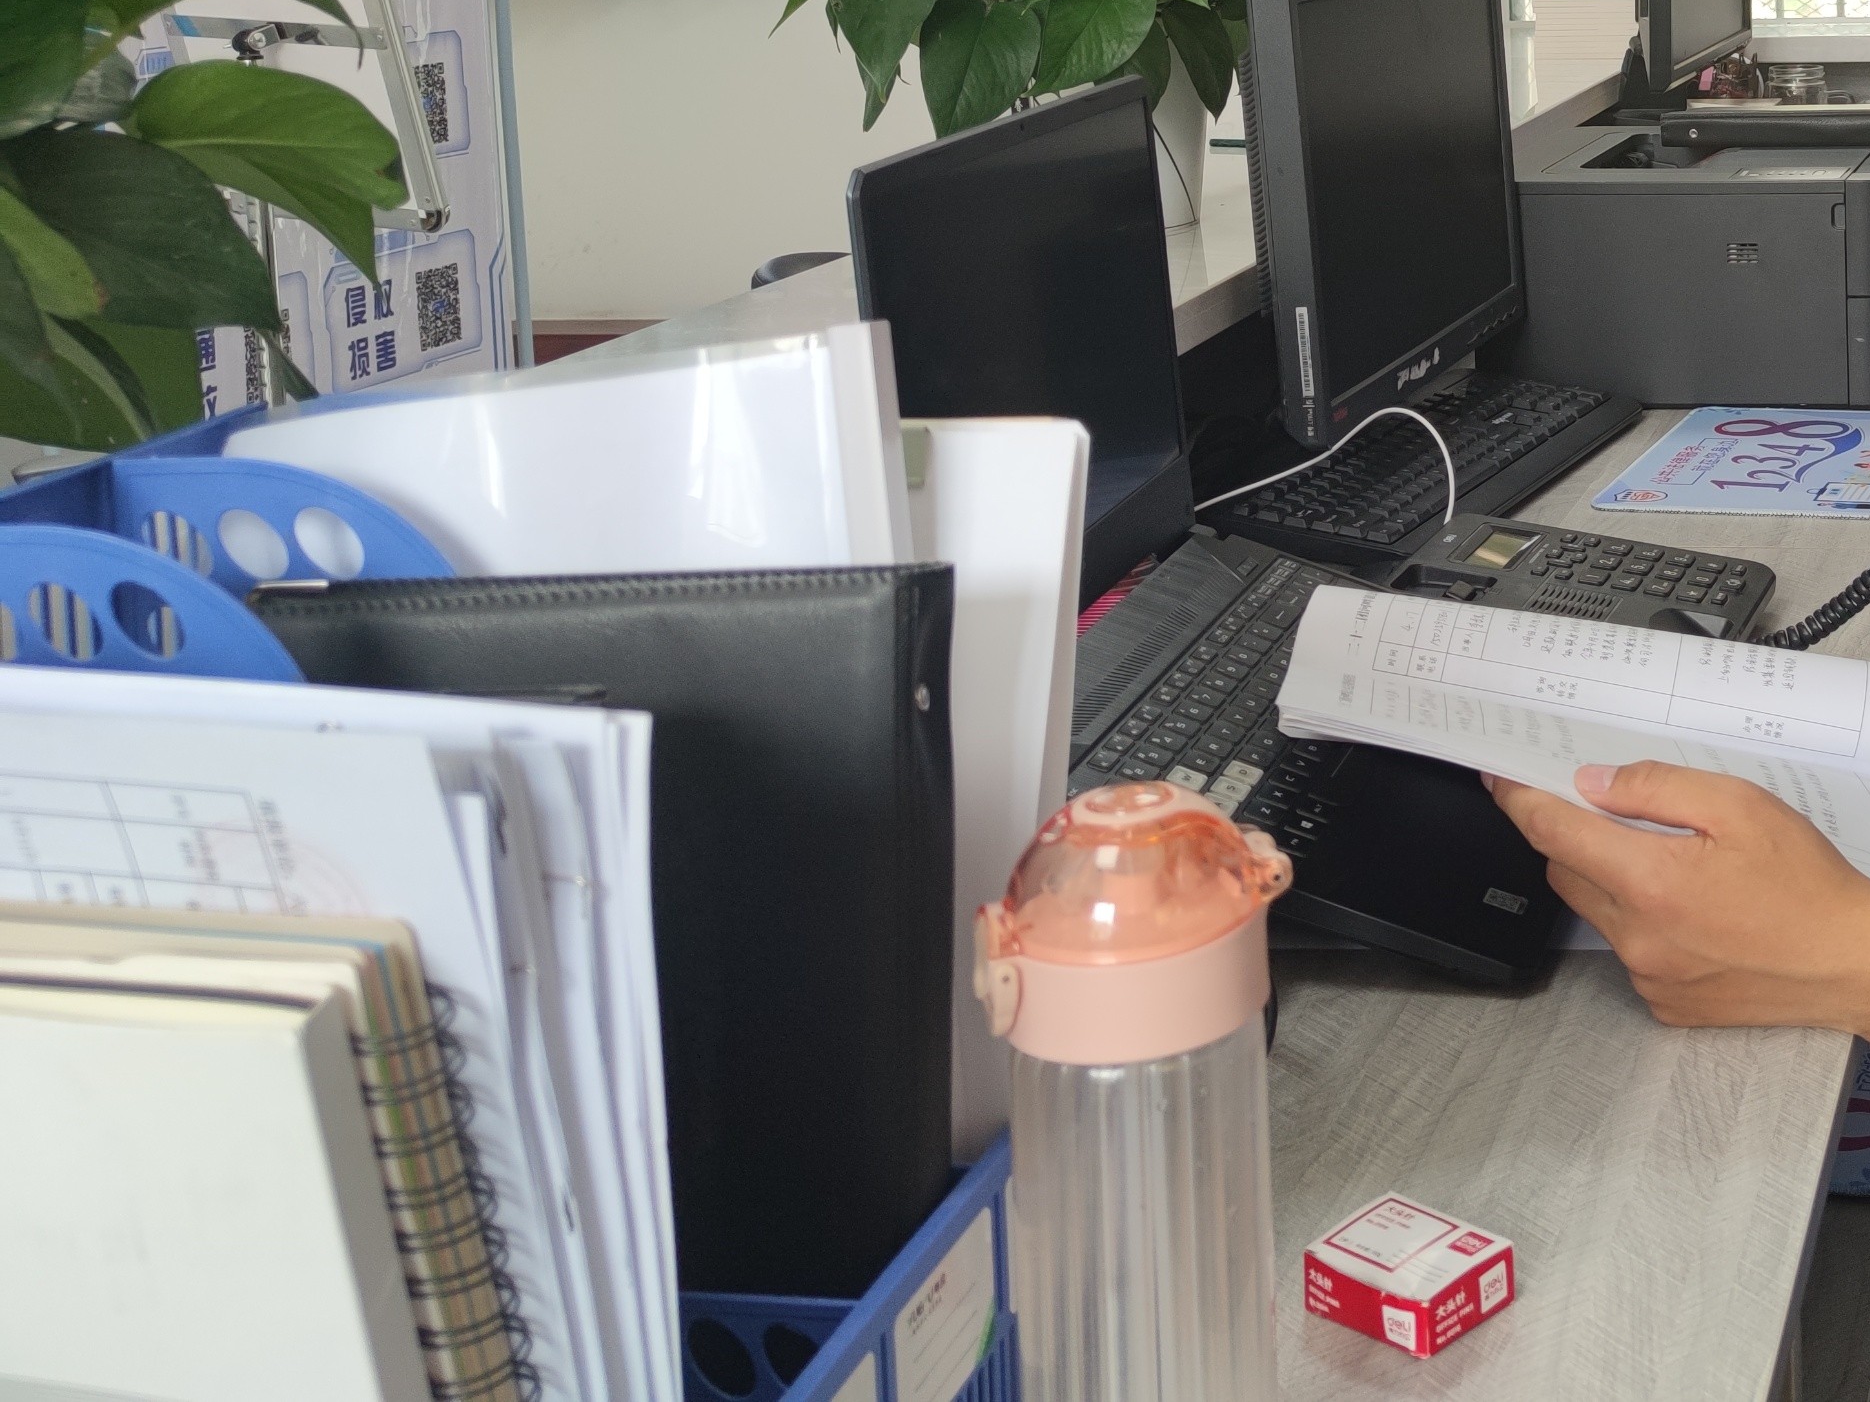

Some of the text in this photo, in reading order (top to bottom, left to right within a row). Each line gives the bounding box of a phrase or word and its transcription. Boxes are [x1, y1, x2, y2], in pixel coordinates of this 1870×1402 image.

[344, 278, 395, 329] 侵权
[348, 330, 398, 381] 损害
[1435, 1289, 1467, 1320] 大头针
